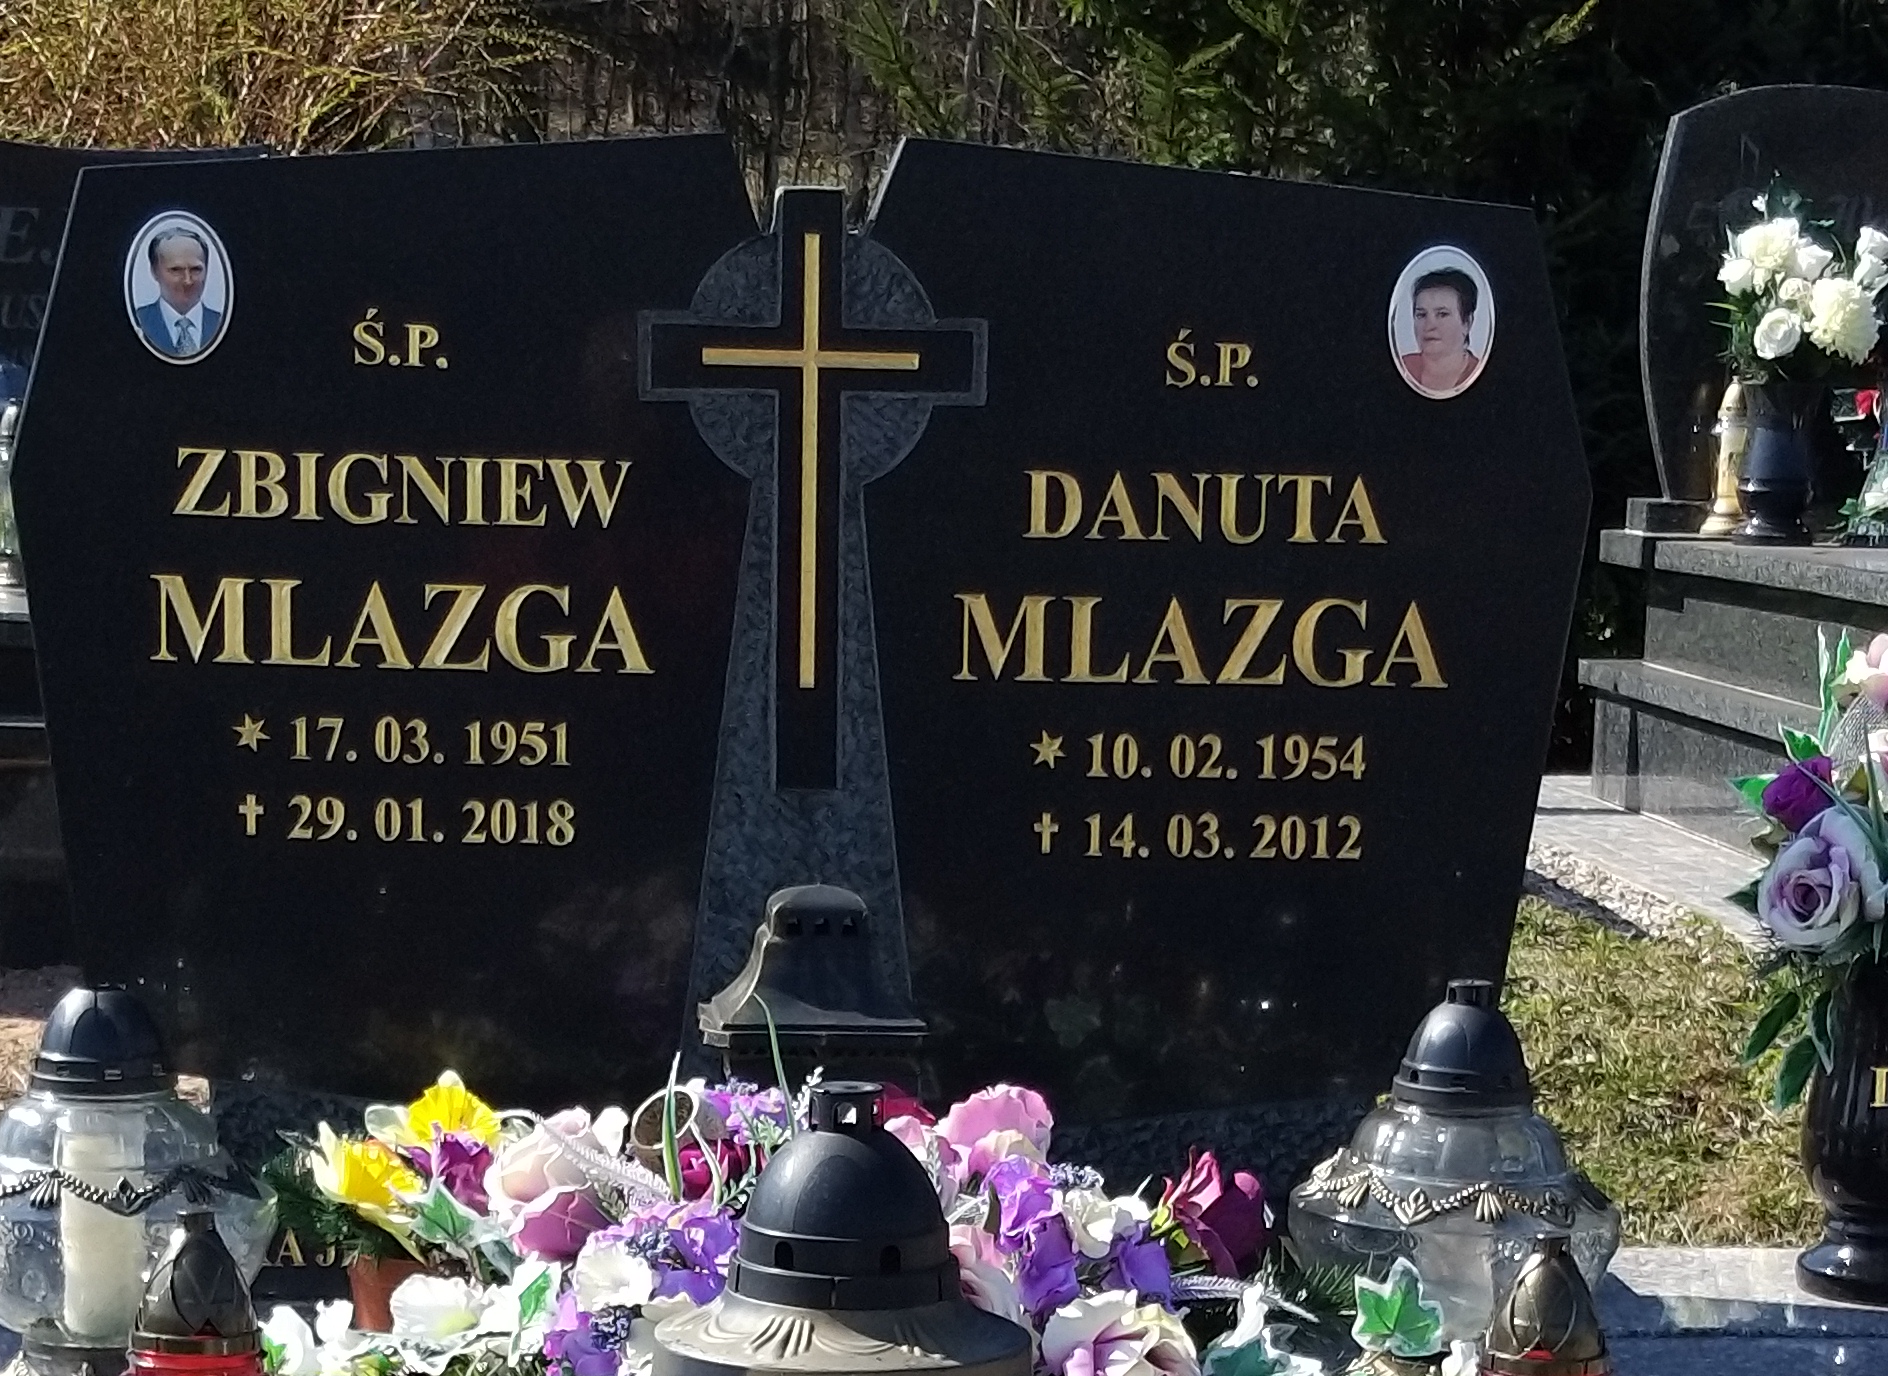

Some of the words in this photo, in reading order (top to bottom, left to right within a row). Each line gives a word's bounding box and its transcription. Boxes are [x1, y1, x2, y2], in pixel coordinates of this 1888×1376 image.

[353, 307, 449, 369] Ś.P.
[1165, 328, 1259, 388] Ś.P.
[172, 446, 633, 529] ZBIGNIEW
[1022, 469, 1388, 545] DANUTA
[149, 574, 656, 675] MLAZGA
[952, 593, 1449, 689] MLAZGA
[290, 716, 358, 762] 17.
[374, 716, 445, 765] 03.
[464, 720, 572, 767] 1951
[1086, 732, 1152, 779] 10.
[1169, 733, 1238, 780] 02.
[1255, 733, 1367, 781] 1954
[287, 794, 358, 841] 29.
[374, 797, 445, 844] 01.
[461, 798, 576, 846] 2018
[1084, 812, 1150, 858] 14.
[1166, 812, 1235, 859] 03.
[1249, 814, 1363, 860] 2012
